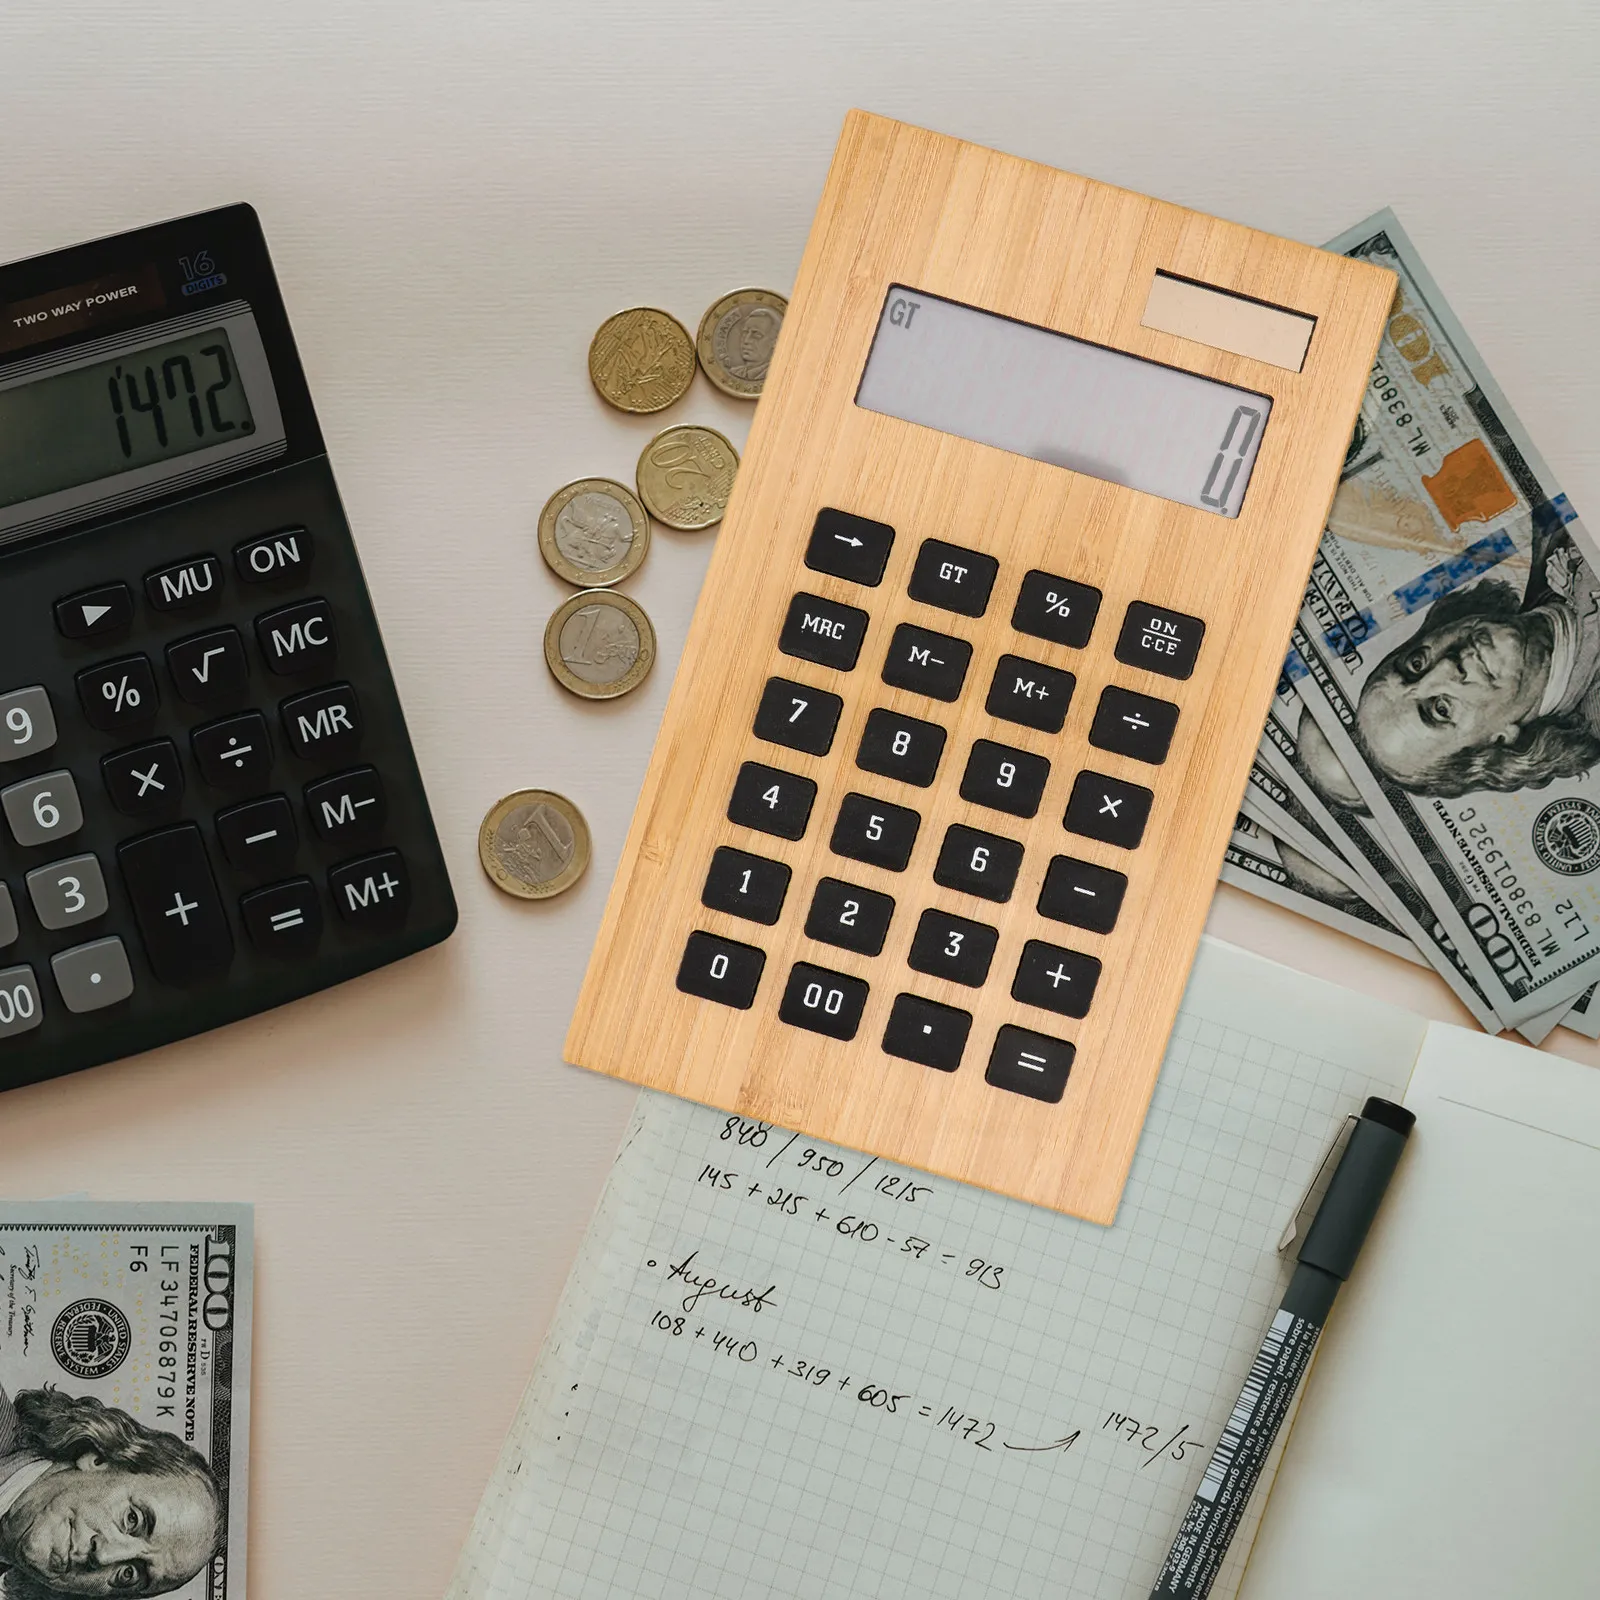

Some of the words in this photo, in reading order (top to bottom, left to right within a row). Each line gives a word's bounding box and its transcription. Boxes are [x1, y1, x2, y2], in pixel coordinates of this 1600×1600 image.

[179, 250, 215, 280] 16
[184, 274, 224, 294] DIGITS
[14, 311, 47, 328] TWO
[51, 302, 83, 320] WAY
[86, 285, 138, 307] POWER
[890, 298, 920, 329] GT
[1408, 427, 1431, 457] ML
[651, 442, 711, 489] 20
[249, 537, 300, 573] ON
[160, 564, 213, 602] MU
[939, 562, 968, 584] GT
[271, 617, 328, 657] MC
[802, 614, 845, 641] MRC
[1151, 618, 1177, 635] ON
[1013, 677, 1049, 700] M+
[791, 699, 808, 723] 7
[1321, 682, 1355, 726] ONE
[6, 708, 33, 744] 9
[298, 705, 353, 743] MR
[892, 732, 911, 755] 8
[997, 763, 1016, 788] 9
[33, 792, 60, 828] 6
[762, 786, 779, 809] 4
[866, 817, 883, 841] 5
[1432, 798, 1461, 839] NOTE
[971, 848, 990, 872] 6
[1241, 856, 1288, 883] ONE
[1456, 836, 1502, 904] RESERVE
[1467, 820, 1542, 929] 83801932
[58, 877, 86, 913] 3
[344, 872, 399, 911] M+
[739, 870, 752, 893] 1
[840, 901, 859, 926] 2
[945, 932, 964, 957] 3
[1467, 902, 1533, 992] 100
[1496, 901, 1541, 968] FEDERAL
[1532, 927, 1561, 958] ML
[710, 955, 729, 980] 0
[803, 983, 844, 1015] 00
[798, 1149, 844, 1177] 950
[875, 1174, 933, 1202] 1215
[698, 1164, 737, 1190] 145
[767, 1188, 809, 1215] 215
[836, 1216, 878, 1242] 610
[901, 1237, 931, 1258] 57
[966, 1259, 1003, 1290] 913
[130, 1246, 148, 1272] F6
[161, 1246, 179, 1273] LF
[189, 1244, 199, 1317] FEDERAL
[203, 1234, 232, 1330] 100
[667, 1251, 778, 1312] August
[65, 1303, 101, 1319] FEDERAL
[108, 1309, 127, 1339] UNITED
[55, 1320, 66, 1357] RESERVE
[158, 1279, 179, 1395] 34706879
[1287, 1317, 1306, 1346] sobre
[1301, 1330, 1311, 1341] la
[65, 1359, 98, 1374] SYSTEM
[106, 1342, 126, 1368] STATES
[186, 1318, 197, 1395] RESERVE
[1272, 1345, 1293, 1378] papel,
[651, 1311, 685, 1336] 108
[713, 1332, 758, 1362] 440
[788, 1361, 830, 1386] 319
[858, 1385, 910, 1413] 605
[936, 1407, 996, 1451] 1472
[156, 1405, 175, 1418] K
[1252, 1378, 1279, 1427] resistente
[1264, 1381, 1289, 1427] conserver
[185, 1399, 195, 1441] NOTE
[1248, 1427, 1257, 1435] a
[1234, 1447, 1250, 1467] luz,
[1244, 1436, 1255, 1448] la
[1251, 1436, 1266, 1456] plat
[1218, 1467, 1242, 1505] guarda
[1238, 1465, 1254, 1489] tinta
[1190, 1501, 1203, 1519] Art.
[1192, 1504, 1210, 1534] MADE
[1212, 1488, 1244, 1548] documento,
[1184, 1519, 1194, 1533] Nr.
[1187, 1533, 1198, 1546] IN
[1167, 1551, 1181, 1572] 03-9
[1183, 1504, 1226, 1589] horizontalmente
[1166, 1545, 1193, 1593] GERMANY
